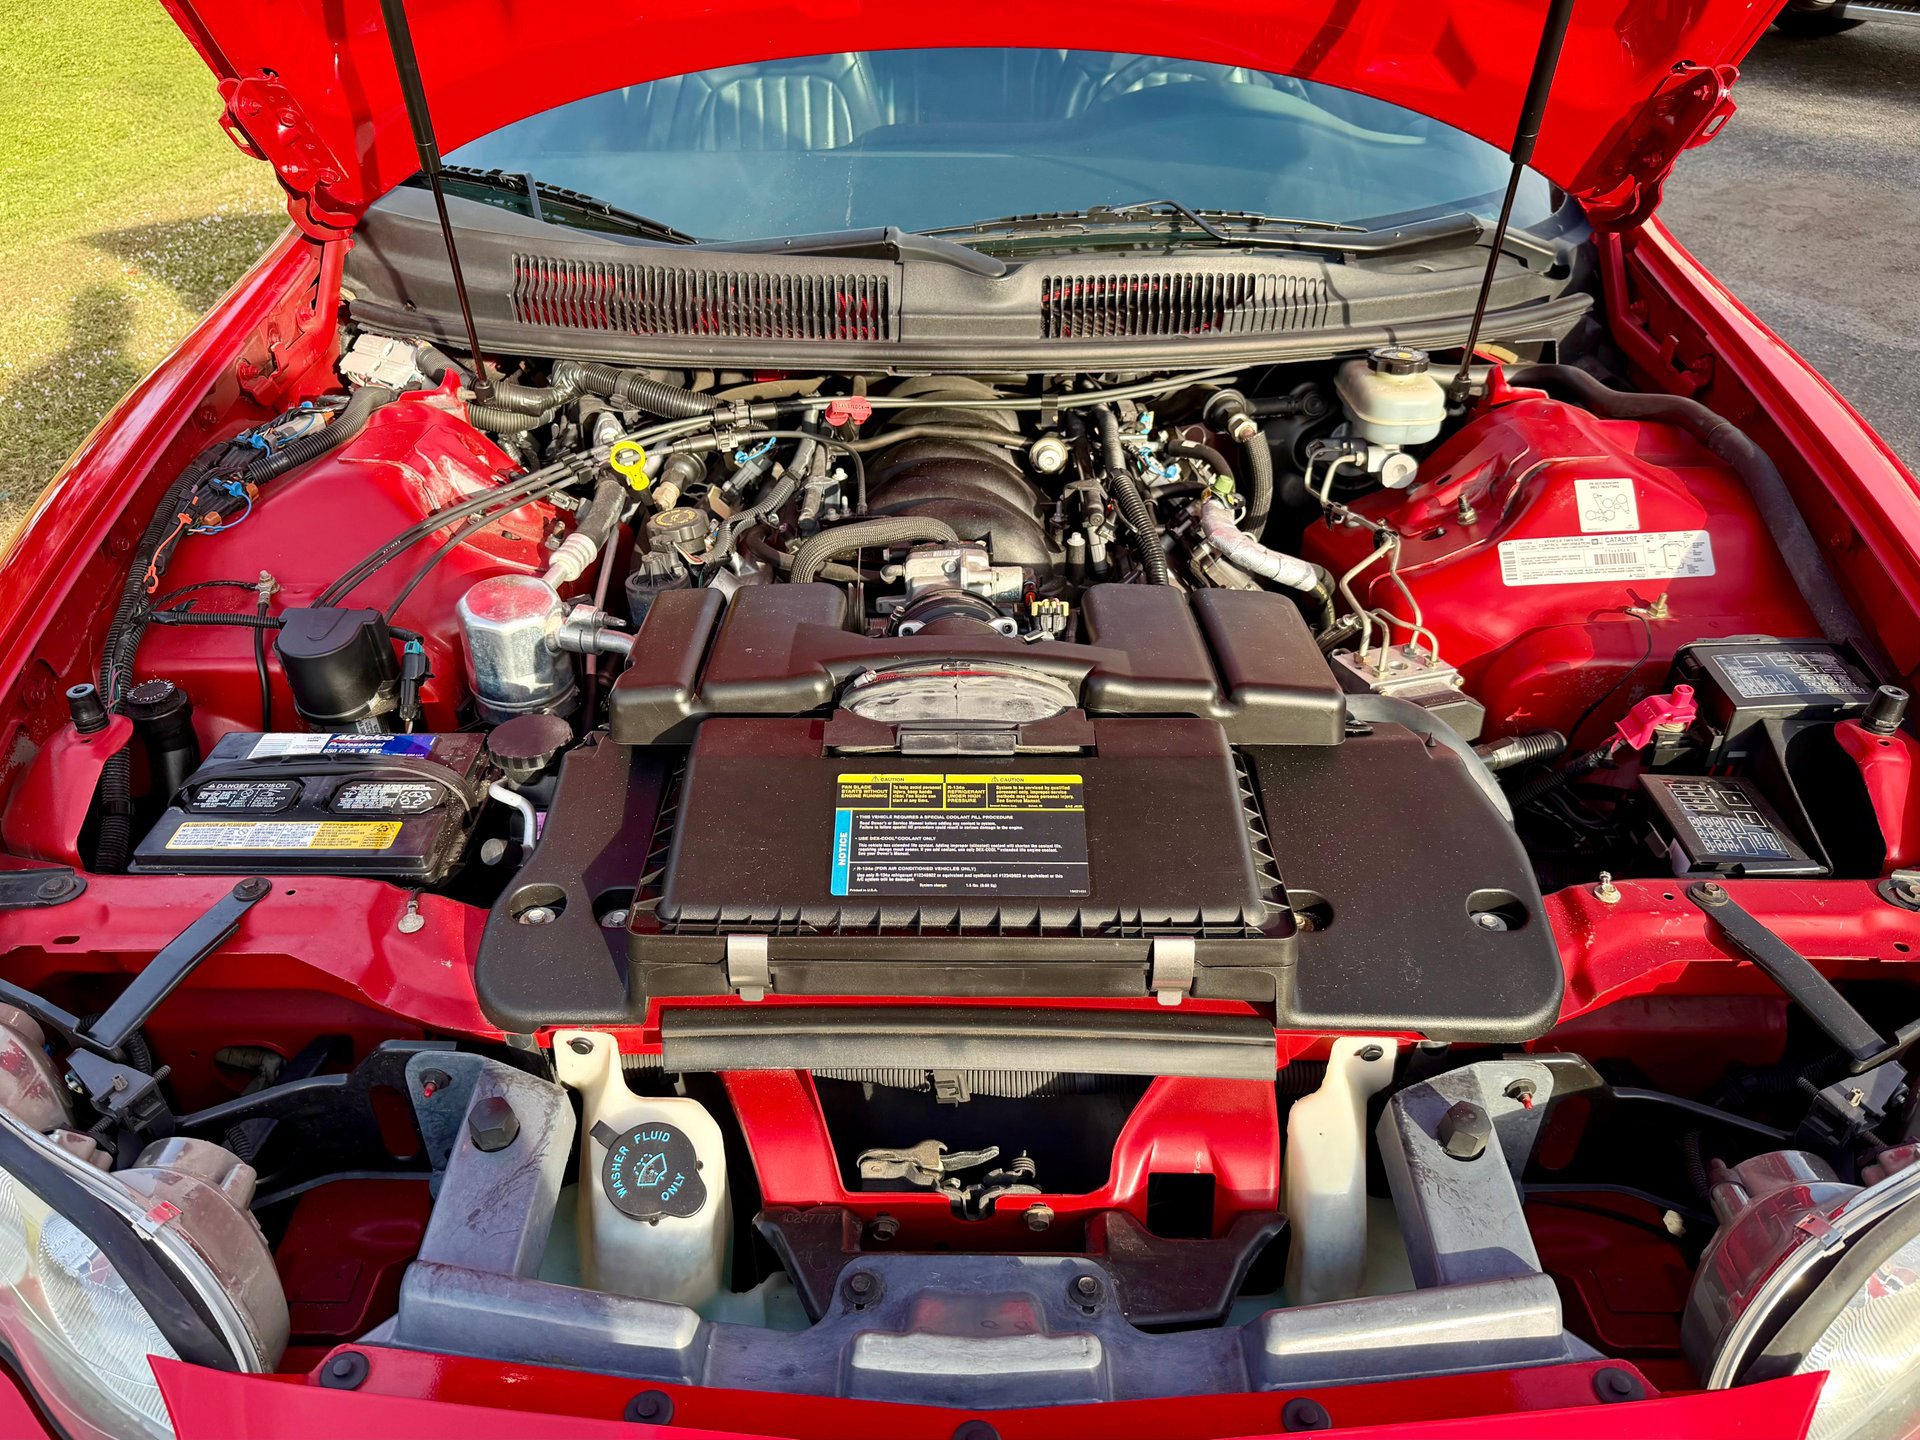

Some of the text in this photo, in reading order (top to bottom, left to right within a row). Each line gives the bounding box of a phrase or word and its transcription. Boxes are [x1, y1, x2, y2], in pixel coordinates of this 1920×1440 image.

[838, 832, 848, 866] NOTICE
[611, 1130, 671, 1198] WASHER FLUID
[661, 1172, 685, 1200] ONLY
